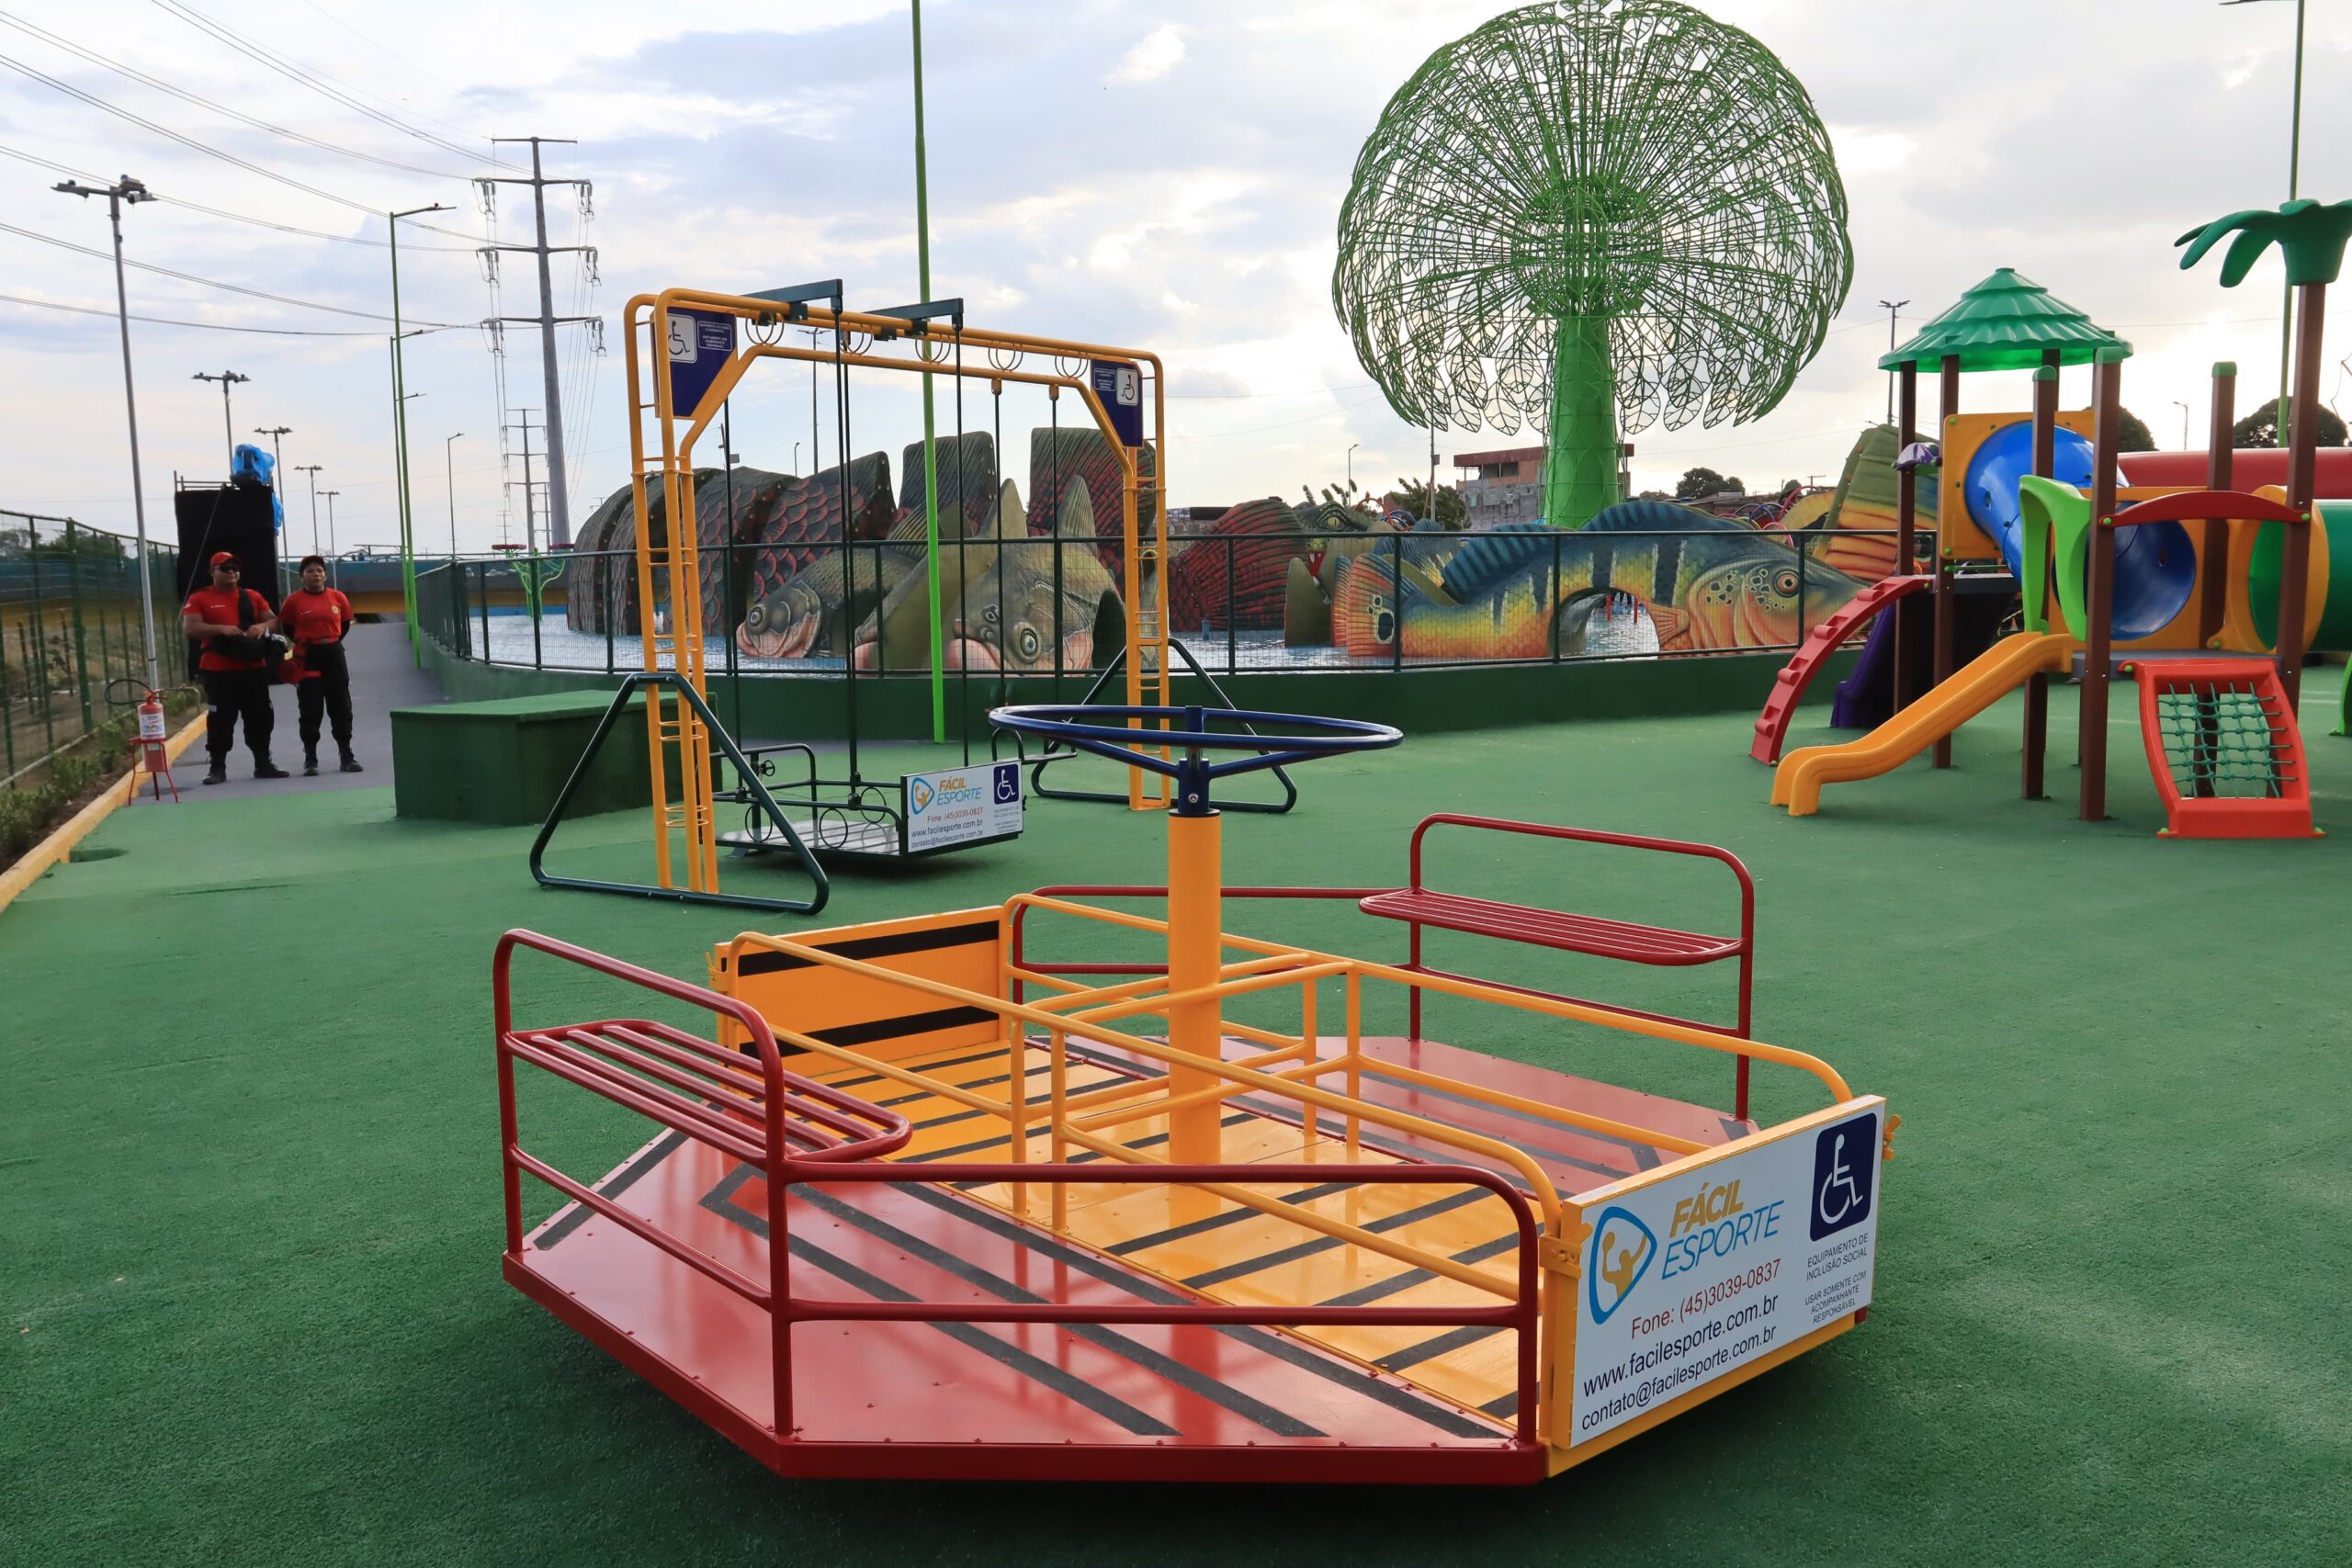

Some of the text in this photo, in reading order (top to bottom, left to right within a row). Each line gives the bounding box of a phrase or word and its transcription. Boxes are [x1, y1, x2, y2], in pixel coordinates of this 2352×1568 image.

[936, 787, 983, 806] ESPORTE
[939, 775, 967, 792] FÁCIL
[1668, 1179, 1744, 1238] FÁCIL
[1661, 1200, 1784, 1280] ESPORTE
[1807, 1233, 1869, 1268] EQUIPAMENTO DE
[1806, 1247, 1868, 1281] INCLUSÃO SOCIAL
[1632, 1258, 1781, 1340] Fone: (45)3039-0837
[1804, 1269, 1867, 1305] USAR SOMENTE COM
[1811, 1284, 1860, 1314] ACOMPANHANTE
[1813, 1297, 1856, 1325] RESPONSÁVEL
[1583, 1294, 1779, 1398] www.facilesporte.com.br
[1581, 1325, 1776, 1431] contato@facilesporte.com.br
